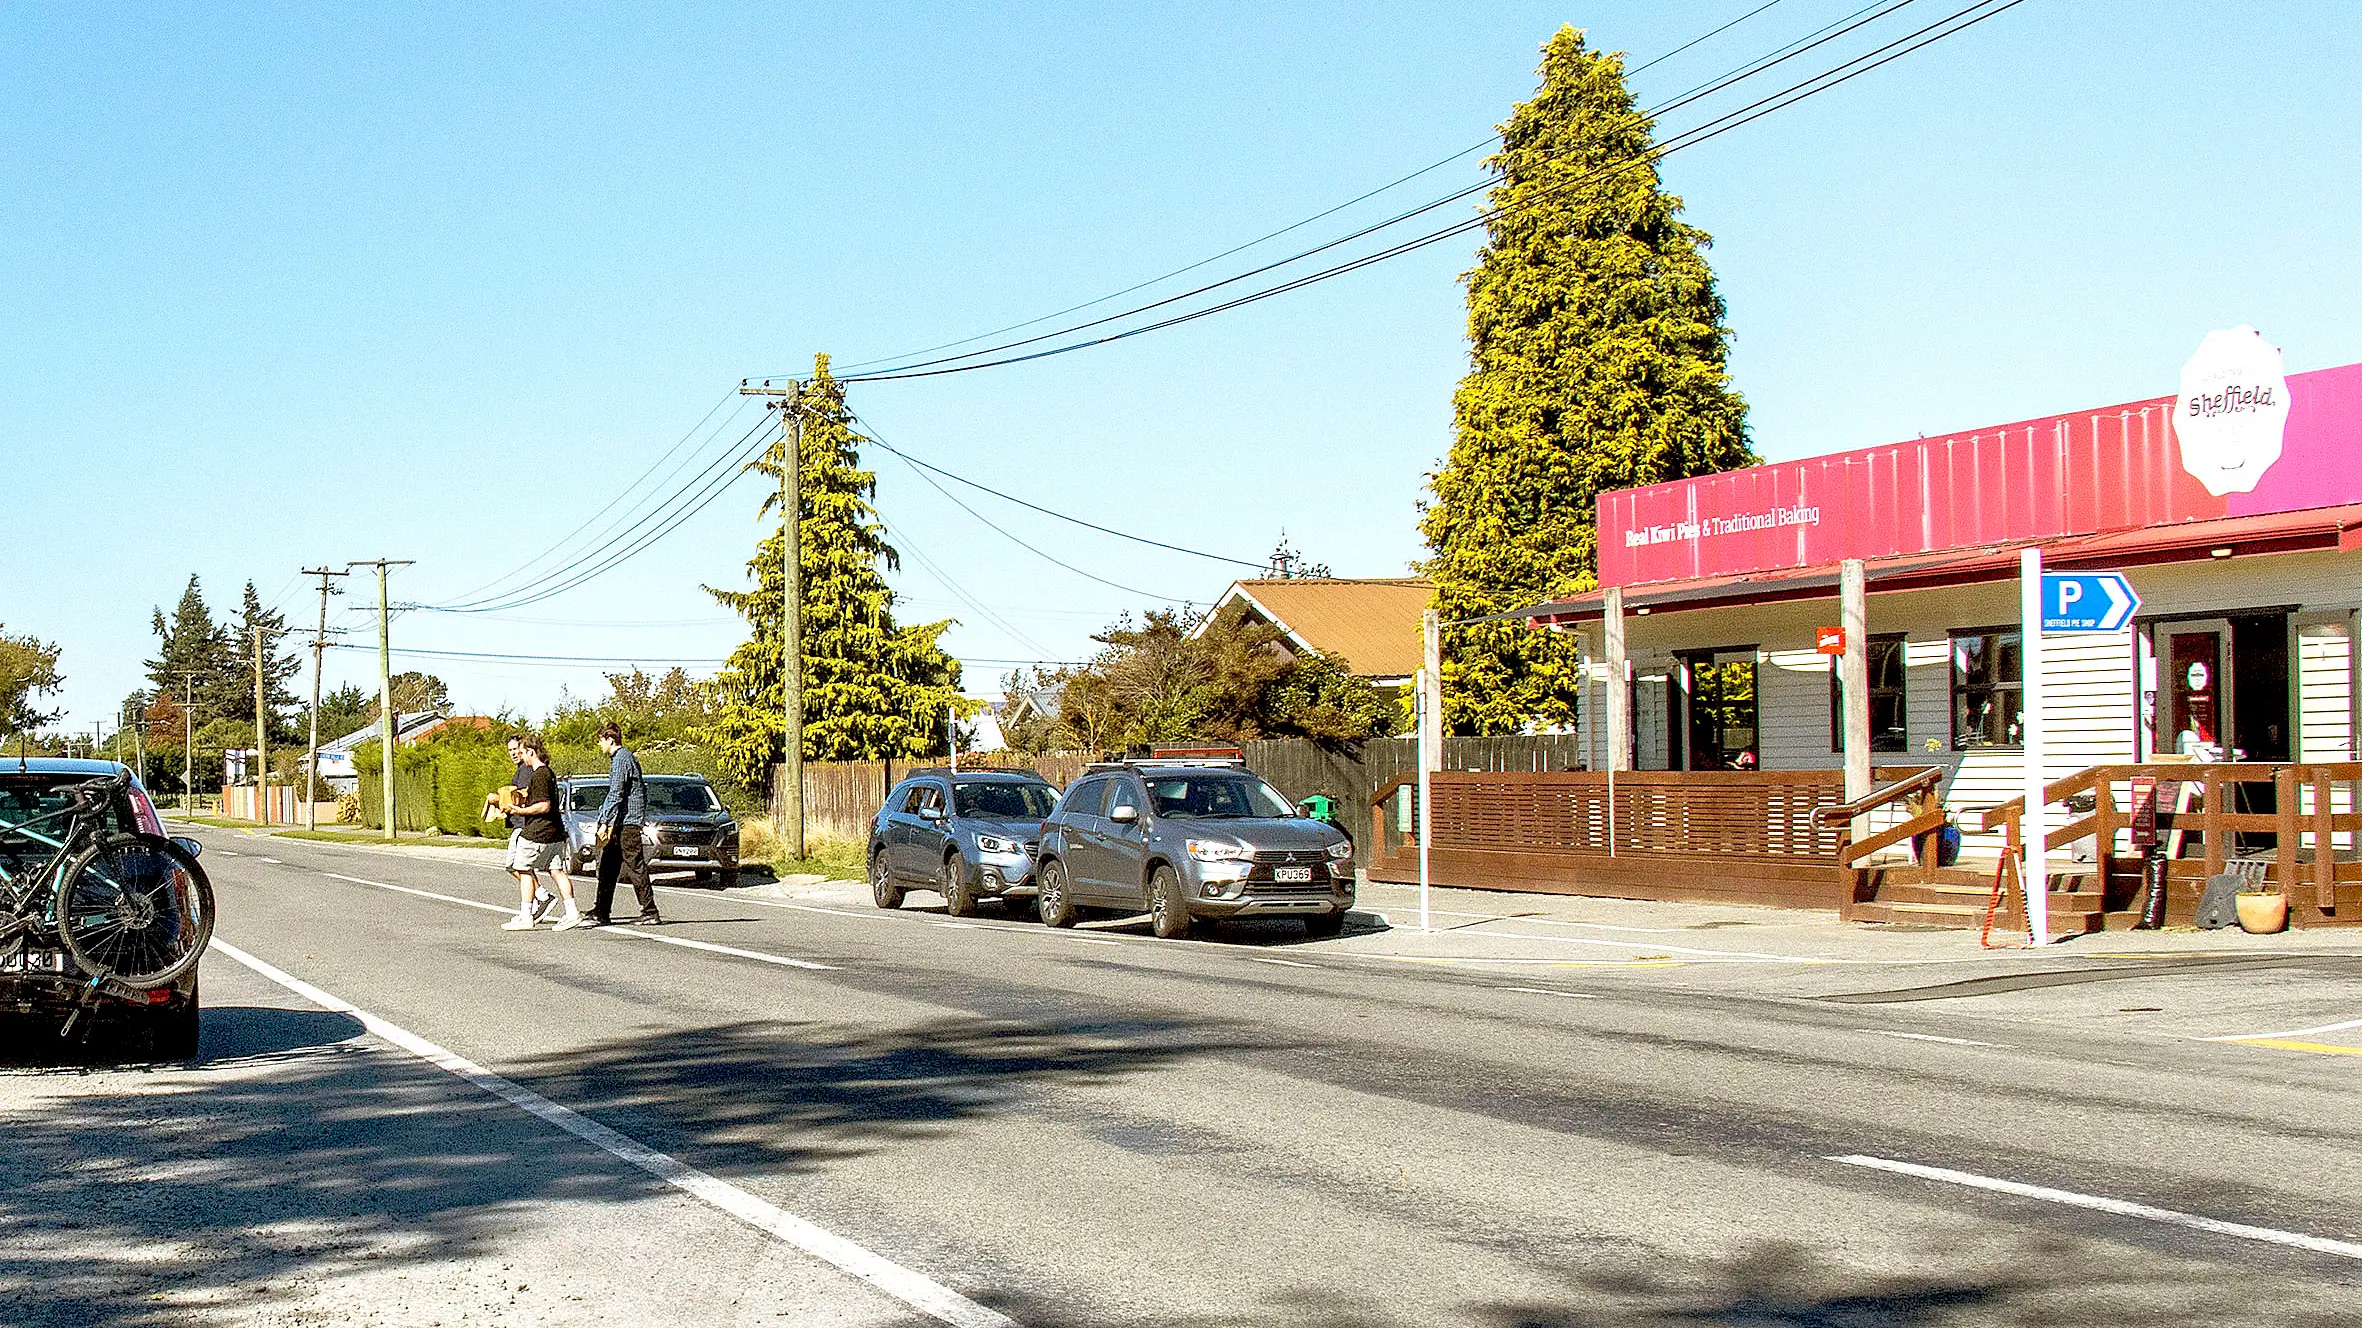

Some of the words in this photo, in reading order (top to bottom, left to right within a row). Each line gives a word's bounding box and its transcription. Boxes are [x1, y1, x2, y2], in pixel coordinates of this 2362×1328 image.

[1625, 527, 1649, 547] Real
[1650, 523, 1675, 544] Kiwi
[1676, 520, 1700, 541] Pies
[1702, 518, 1711, 537] &
[1711, 508, 1776, 536] Traditional
[1777, 505, 1820, 527] Baking
[2059, 580, 2083, 615] P
[1275, 869, 1310, 880] KPU369
